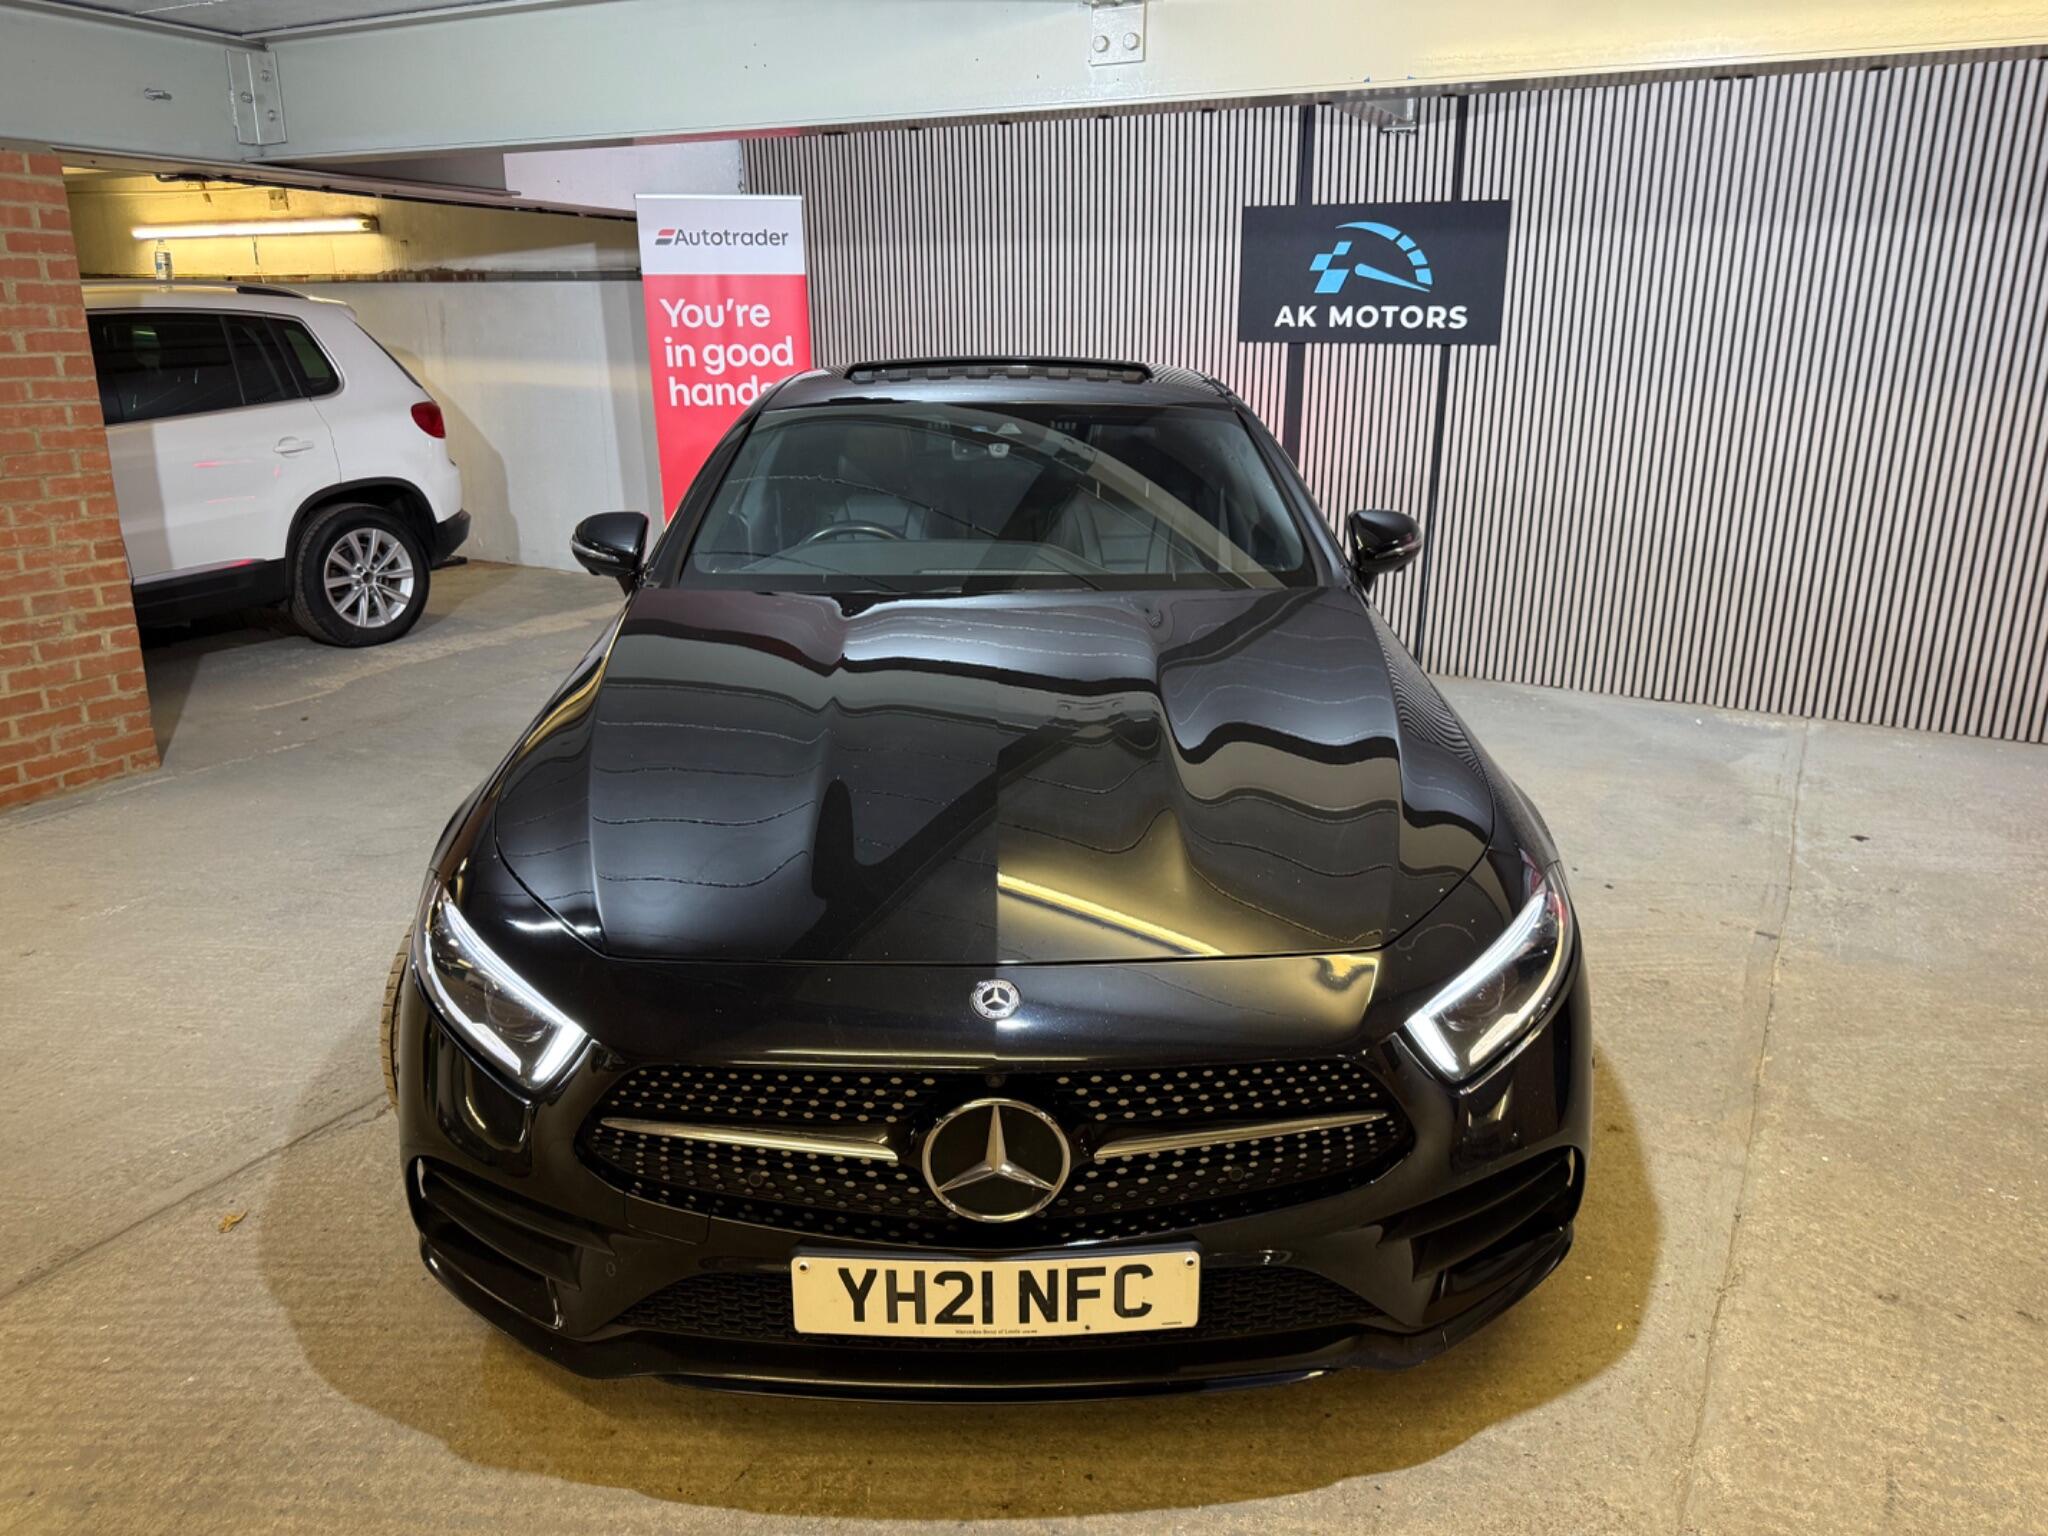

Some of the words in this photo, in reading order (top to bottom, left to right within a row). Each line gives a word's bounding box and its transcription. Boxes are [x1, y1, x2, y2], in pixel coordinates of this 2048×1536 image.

[674, 228, 789, 246] Autotrader
[659, 298, 771, 328] You're
[1274, 305, 1318, 328] AK
[1328, 305, 1468, 329] MOTORS
[664, 336, 696, 367] in
[702, 335, 794, 375] good
[838, 1268, 994, 1324] YH21
[1018, 1263, 1154, 1324] NFC
